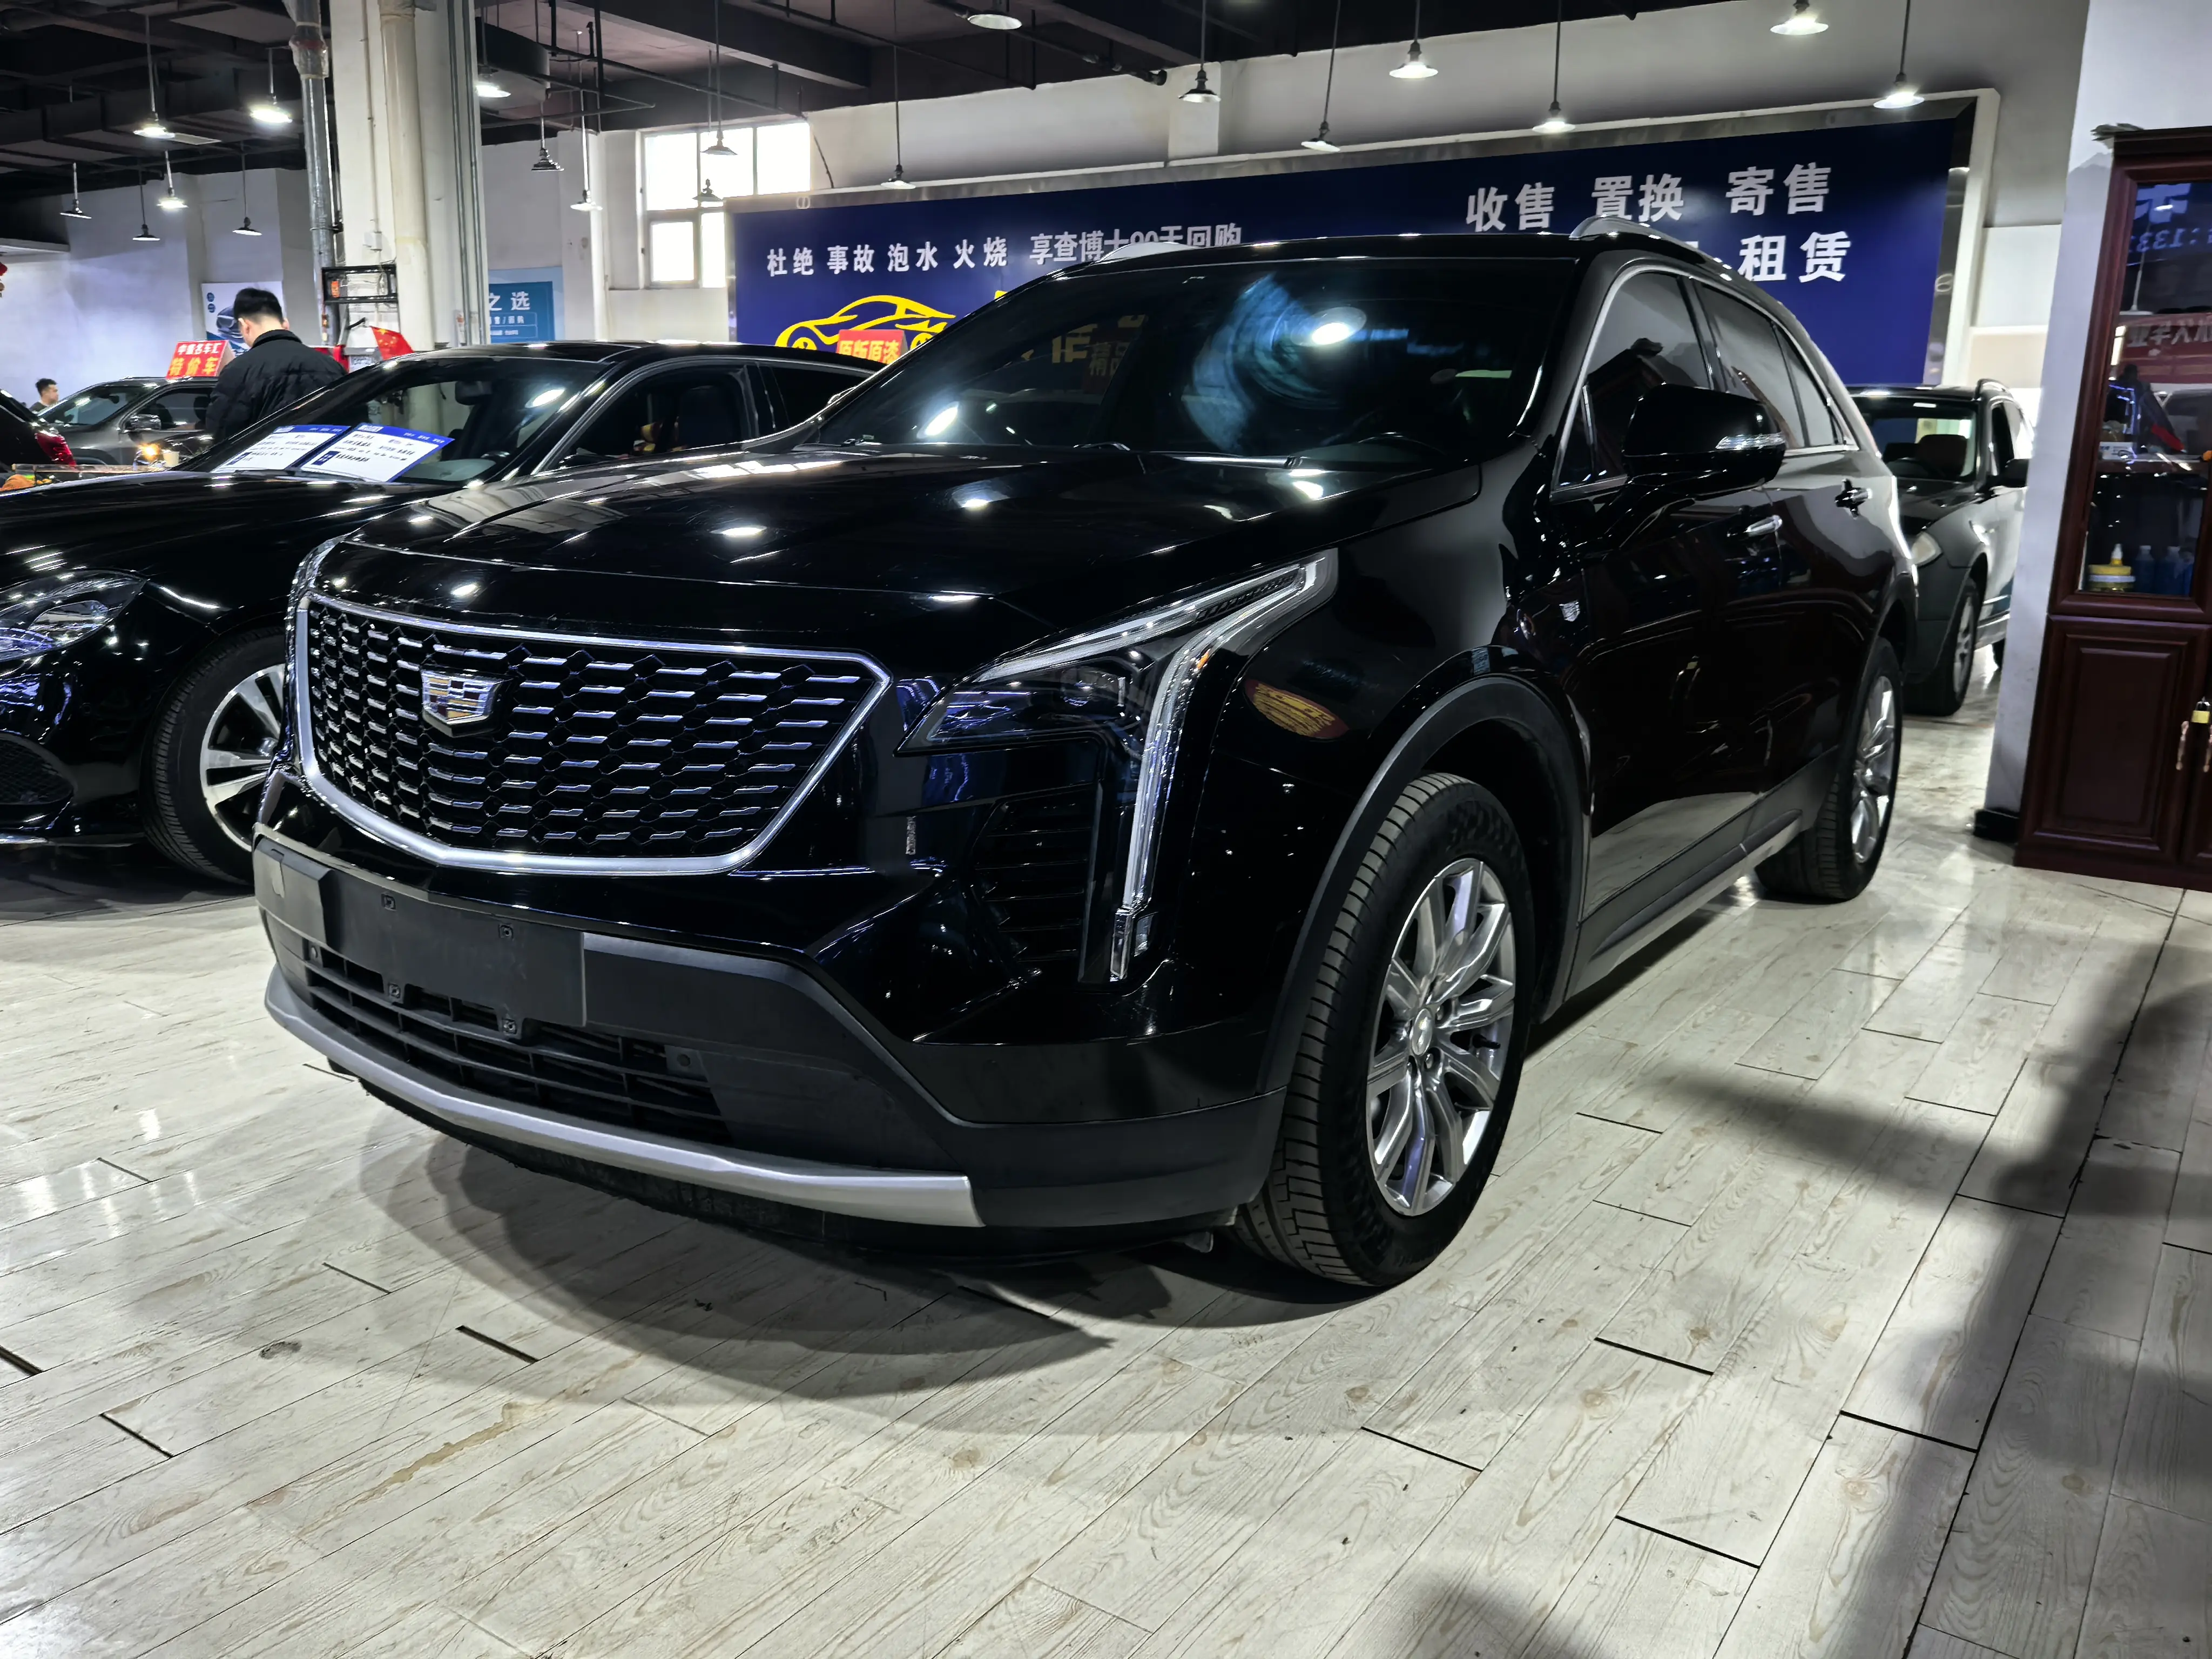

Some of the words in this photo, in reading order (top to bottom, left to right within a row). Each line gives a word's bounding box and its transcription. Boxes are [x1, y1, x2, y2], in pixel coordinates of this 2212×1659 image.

[1466, 182, 1555, 232] 收售
[1591, 173, 1684, 221] 置换
[1725, 162, 1832, 215] 寄售
[767, 247, 814, 276] 杜绝
[827, 244, 874, 274] 事故
[887, 241, 939, 272] 泡水
[953, 237, 1008, 269] 火烧
[1738, 231, 1851, 283] 租赁
